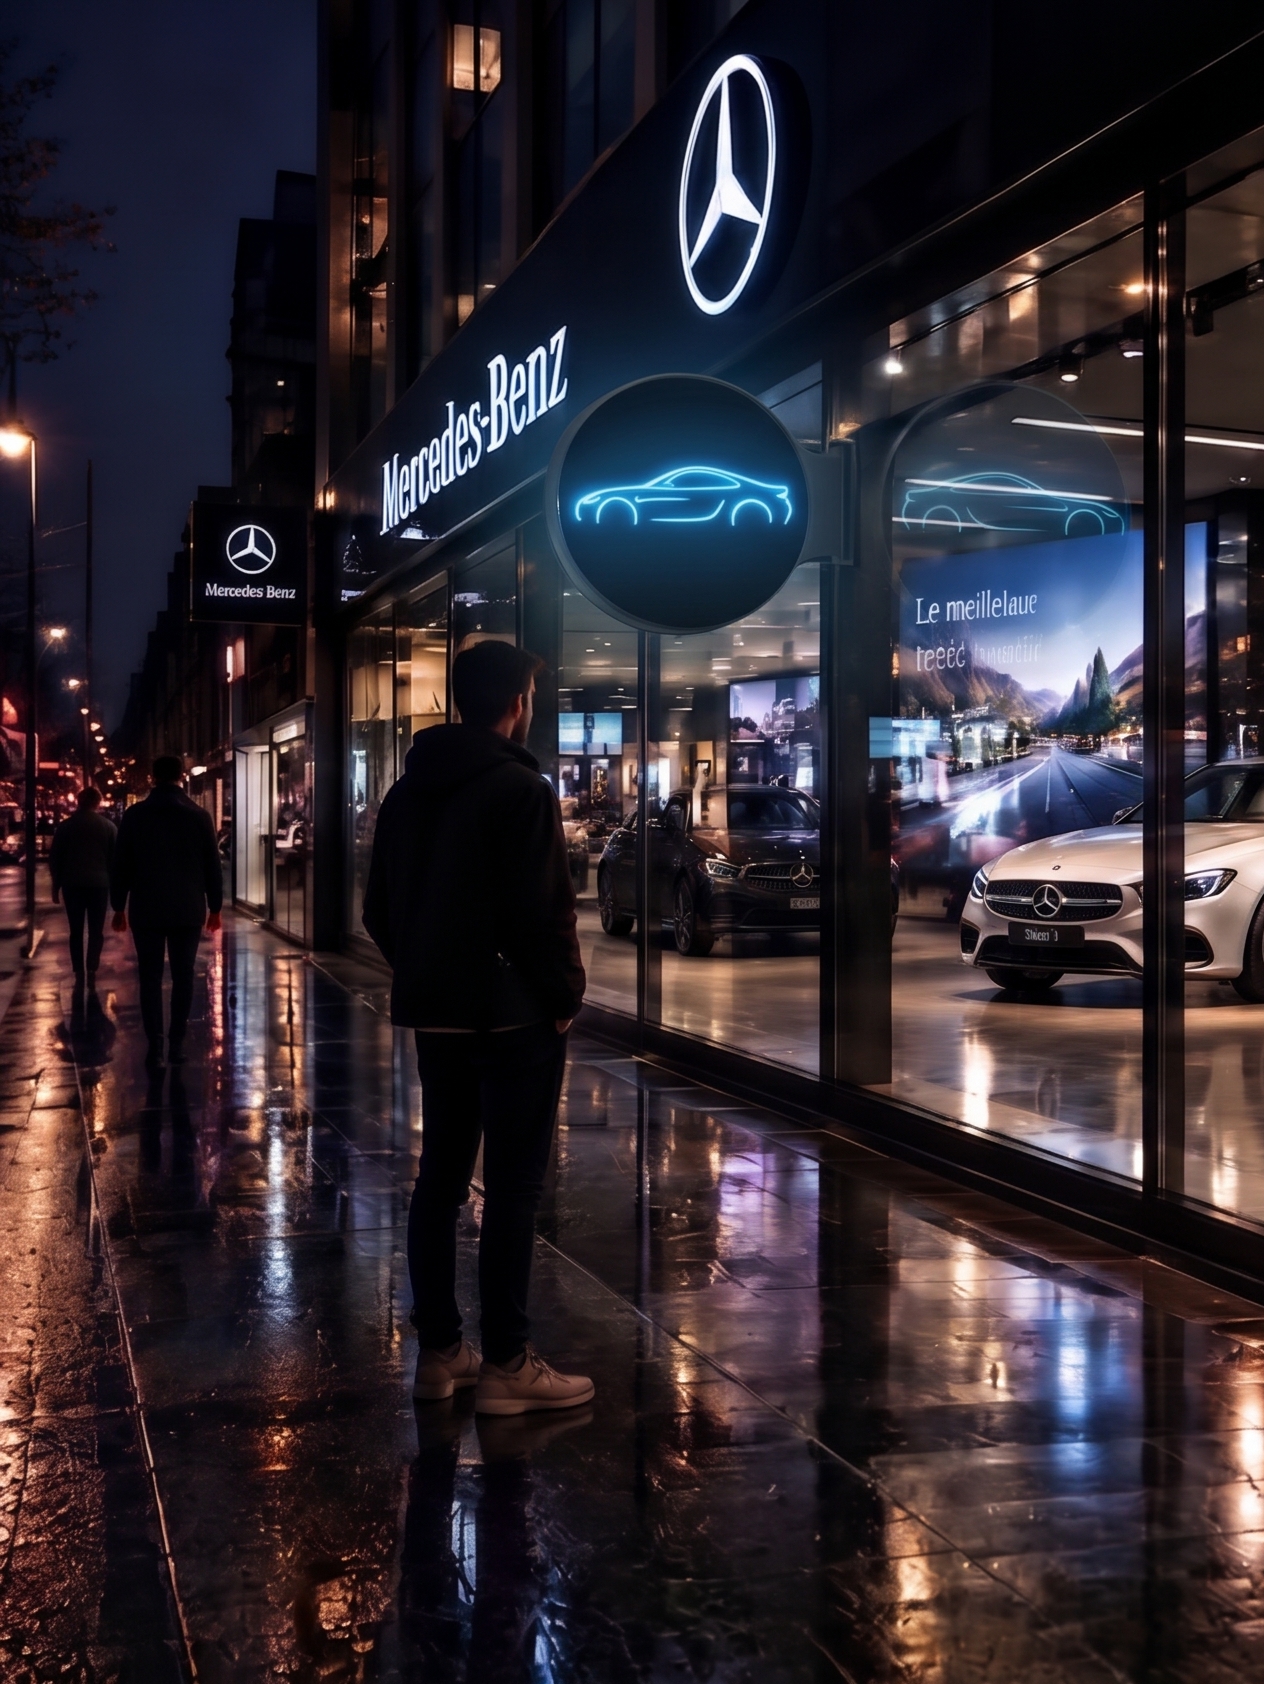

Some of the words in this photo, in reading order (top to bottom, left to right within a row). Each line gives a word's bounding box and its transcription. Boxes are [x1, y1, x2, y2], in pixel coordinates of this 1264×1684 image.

[379, 325, 568, 536] Mercedes-Benz
[205, 582, 264, 598] Mercedes
[266, 585, 296, 599] Benz
[915, 598, 940, 625] Le
